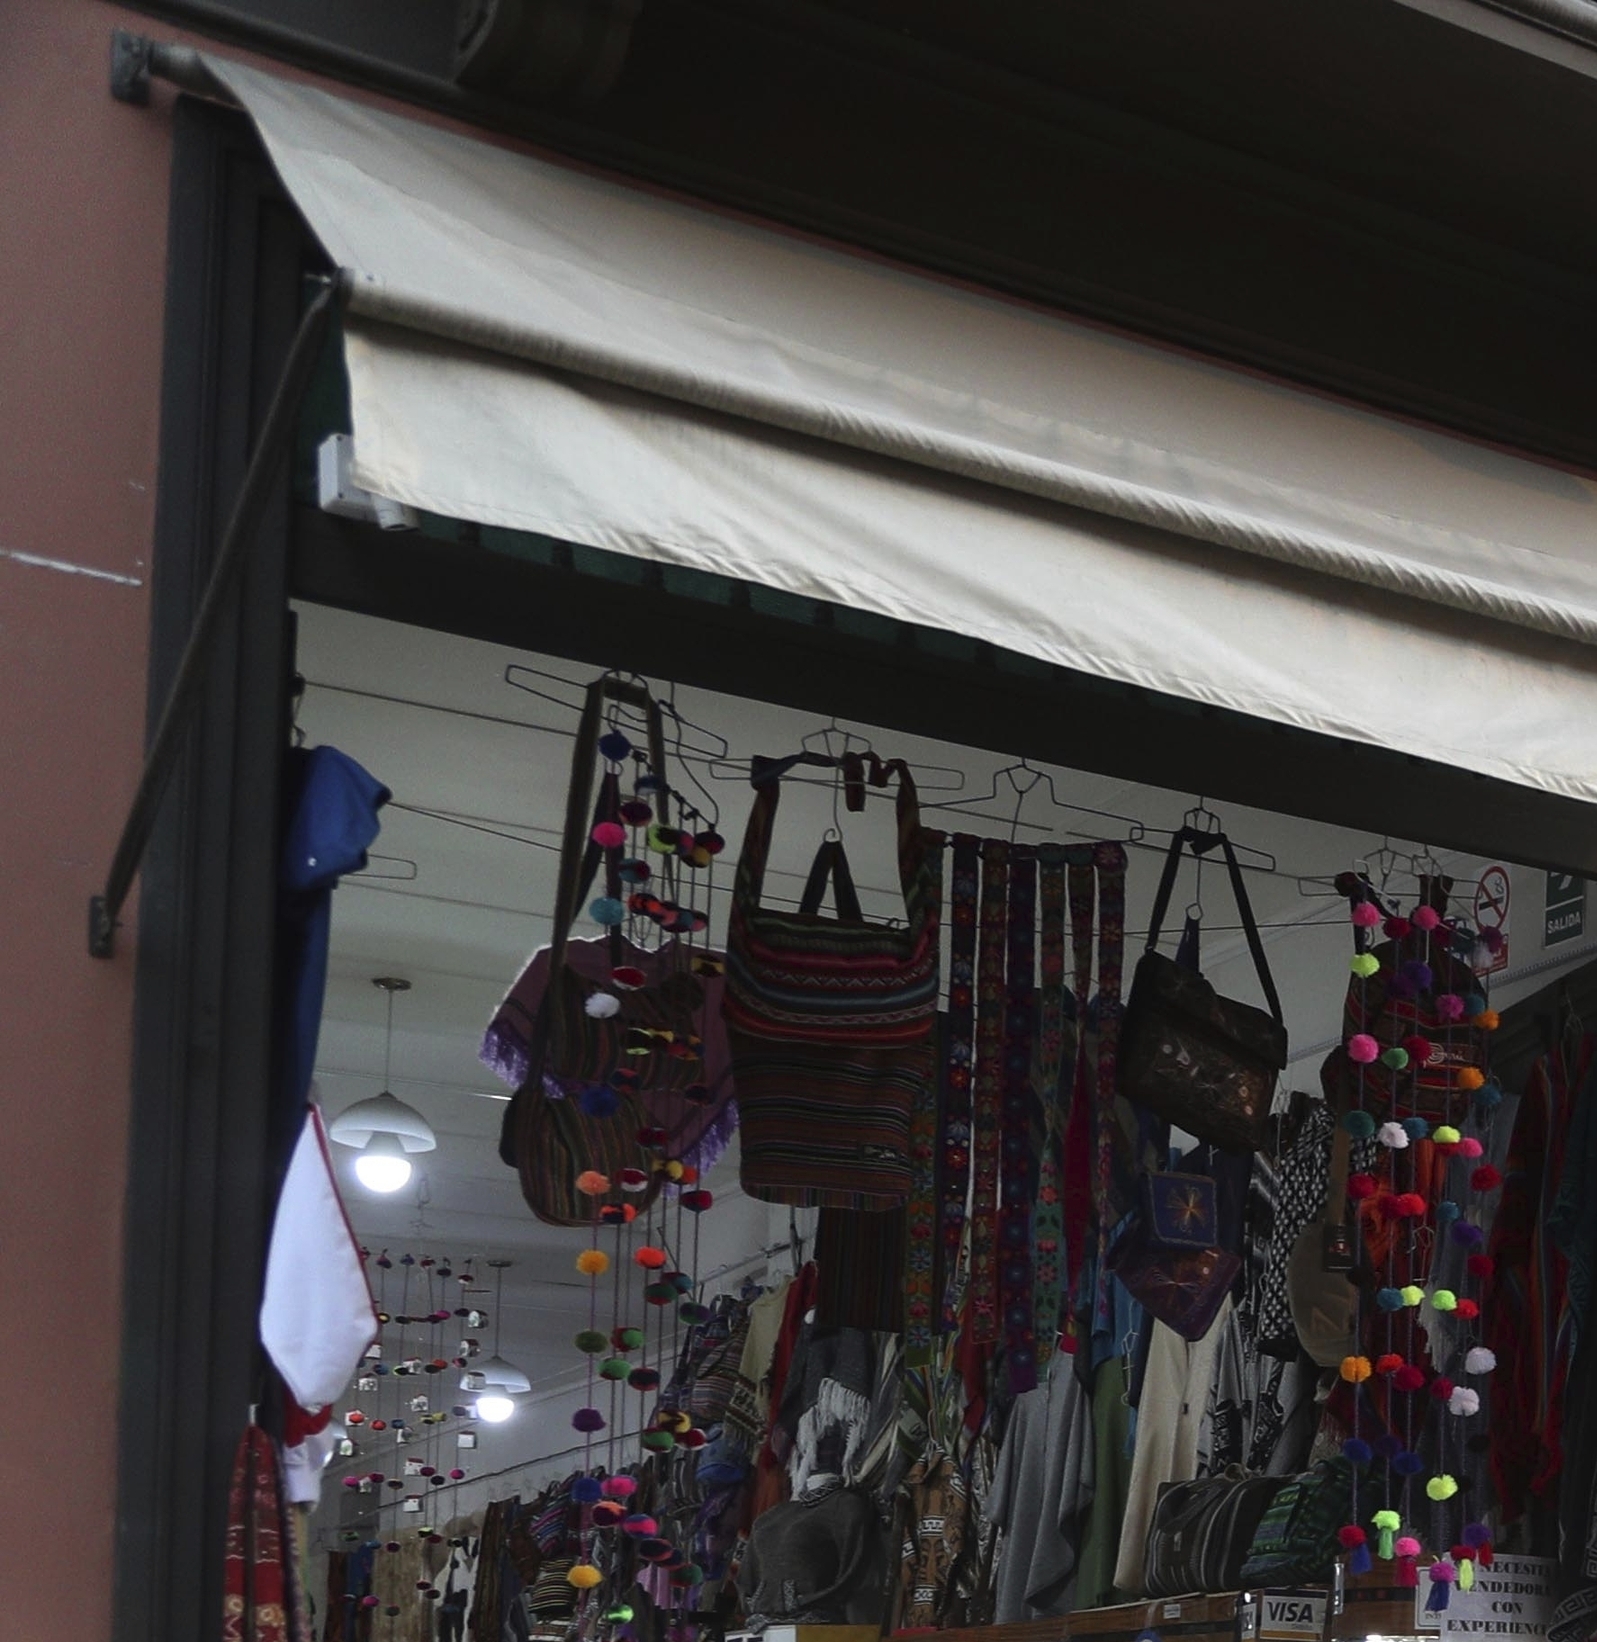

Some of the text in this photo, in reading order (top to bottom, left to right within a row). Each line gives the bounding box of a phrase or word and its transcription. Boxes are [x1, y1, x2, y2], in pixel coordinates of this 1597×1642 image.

[1547, 911, 1581, 934] SALIDA
[1267, 1601, 1314, 1623] VISA
[1491, 1600, 1524, 1615] CON
